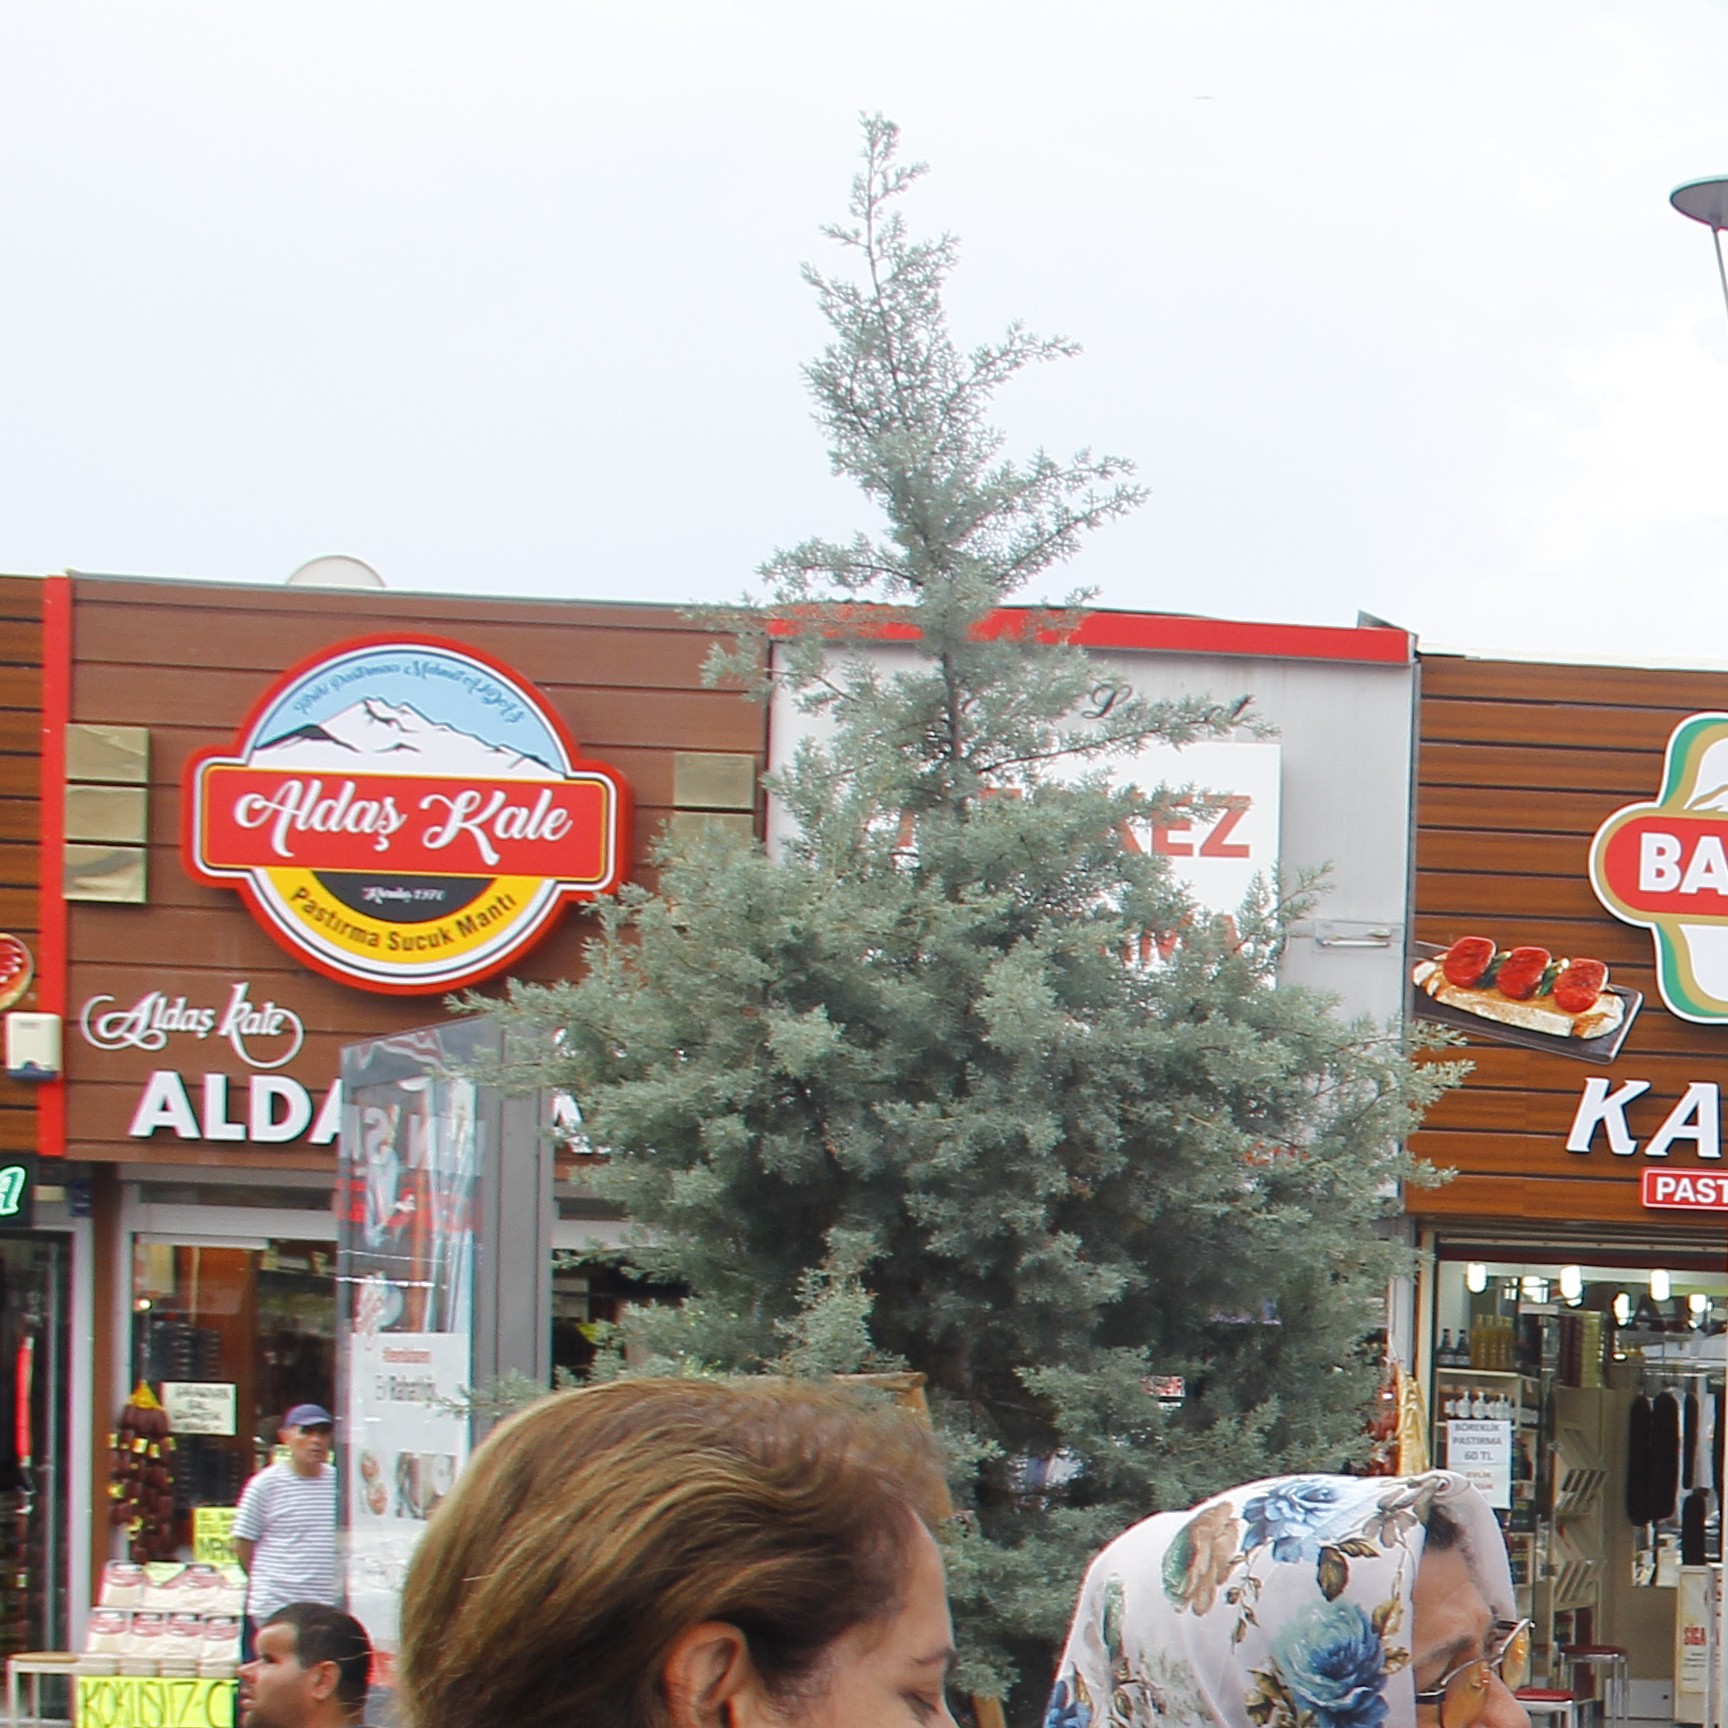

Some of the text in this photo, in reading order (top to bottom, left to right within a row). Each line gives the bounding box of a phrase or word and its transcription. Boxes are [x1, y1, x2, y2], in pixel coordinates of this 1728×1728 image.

[233, 777, 574, 866] Aldaş Kale
[290, 886, 381, 948] Pastırma
[386, 927, 456, 951] Sucuk
[454, 893, 518, 940] Mantı
